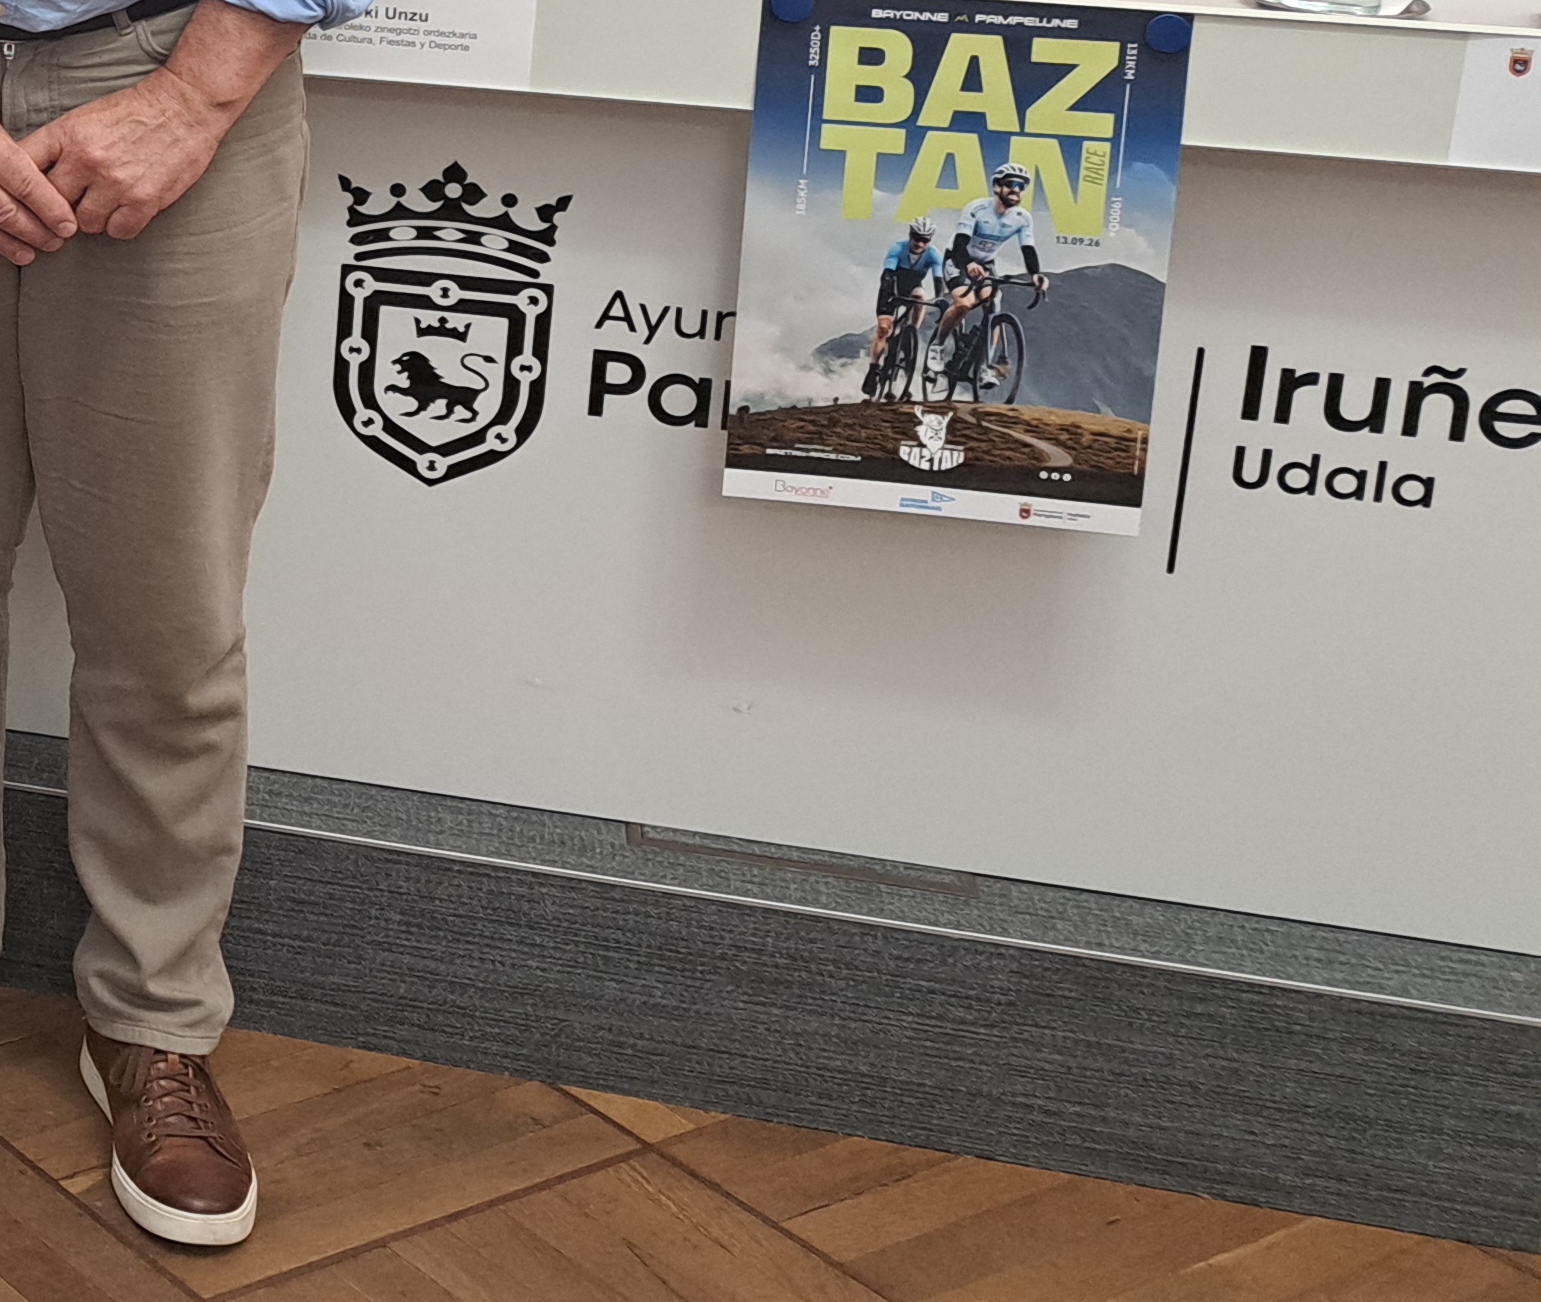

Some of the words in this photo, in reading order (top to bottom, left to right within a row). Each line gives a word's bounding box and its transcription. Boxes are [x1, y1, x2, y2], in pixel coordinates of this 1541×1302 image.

[364, 6, 379, 21] ki
[385, 6, 430, 23] Unzu
[870, 8, 949, 23] BAYONNE
[974, 14, 1079, 29] PAMPELUNE
[320, 33, 333, 41] de
[335, 34, 376, 46] Cultura,
[379, 36, 417, 48] Fiestas
[419, 40, 427, 50] y
[428, 40, 471, 53] Deporte
[822, 25, 1121, 138] BAZ
[819, 123, 1111, 237] TAN
[1082, 146, 1107, 186] RACE
[1054, 235, 1101, 248] 13.09.26
[587, 349, 730, 428] Pa
[1241, 345, 1541, 449] Iruñe
[1232, 446, 1435, 508] Udala
